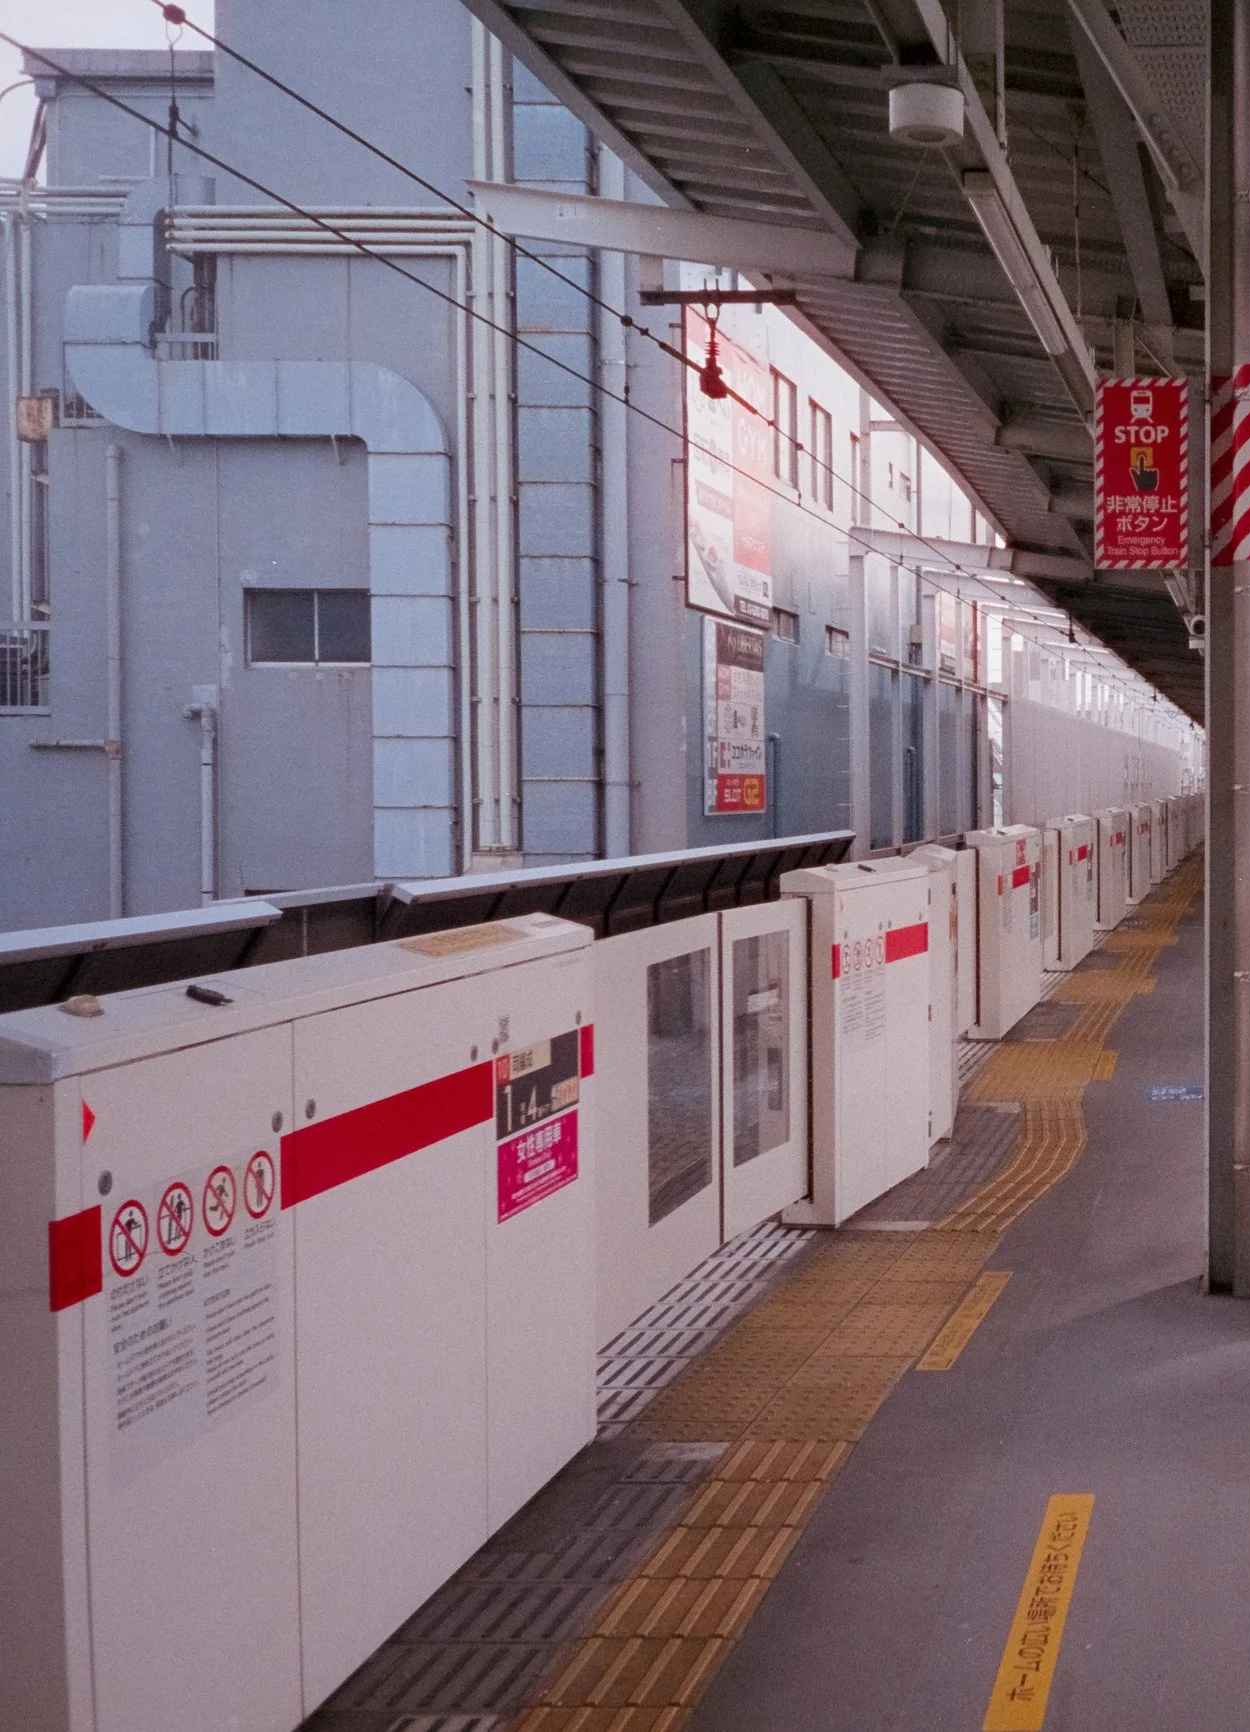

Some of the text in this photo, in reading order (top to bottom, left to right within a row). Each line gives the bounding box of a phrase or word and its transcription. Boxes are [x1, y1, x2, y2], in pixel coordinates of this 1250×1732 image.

[1114, 425, 1169, 444] STOP
[1106, 495, 1178, 514] 非常停止
[1116, 515, 1168, 532] ボタン
[1117, 535, 1166, 546] Emergency
[1107, 546, 1178, 556] Train Stop Button
[527, 1085, 537, 1120] 4
[516, 1122, 562, 1164] 女性専用車
